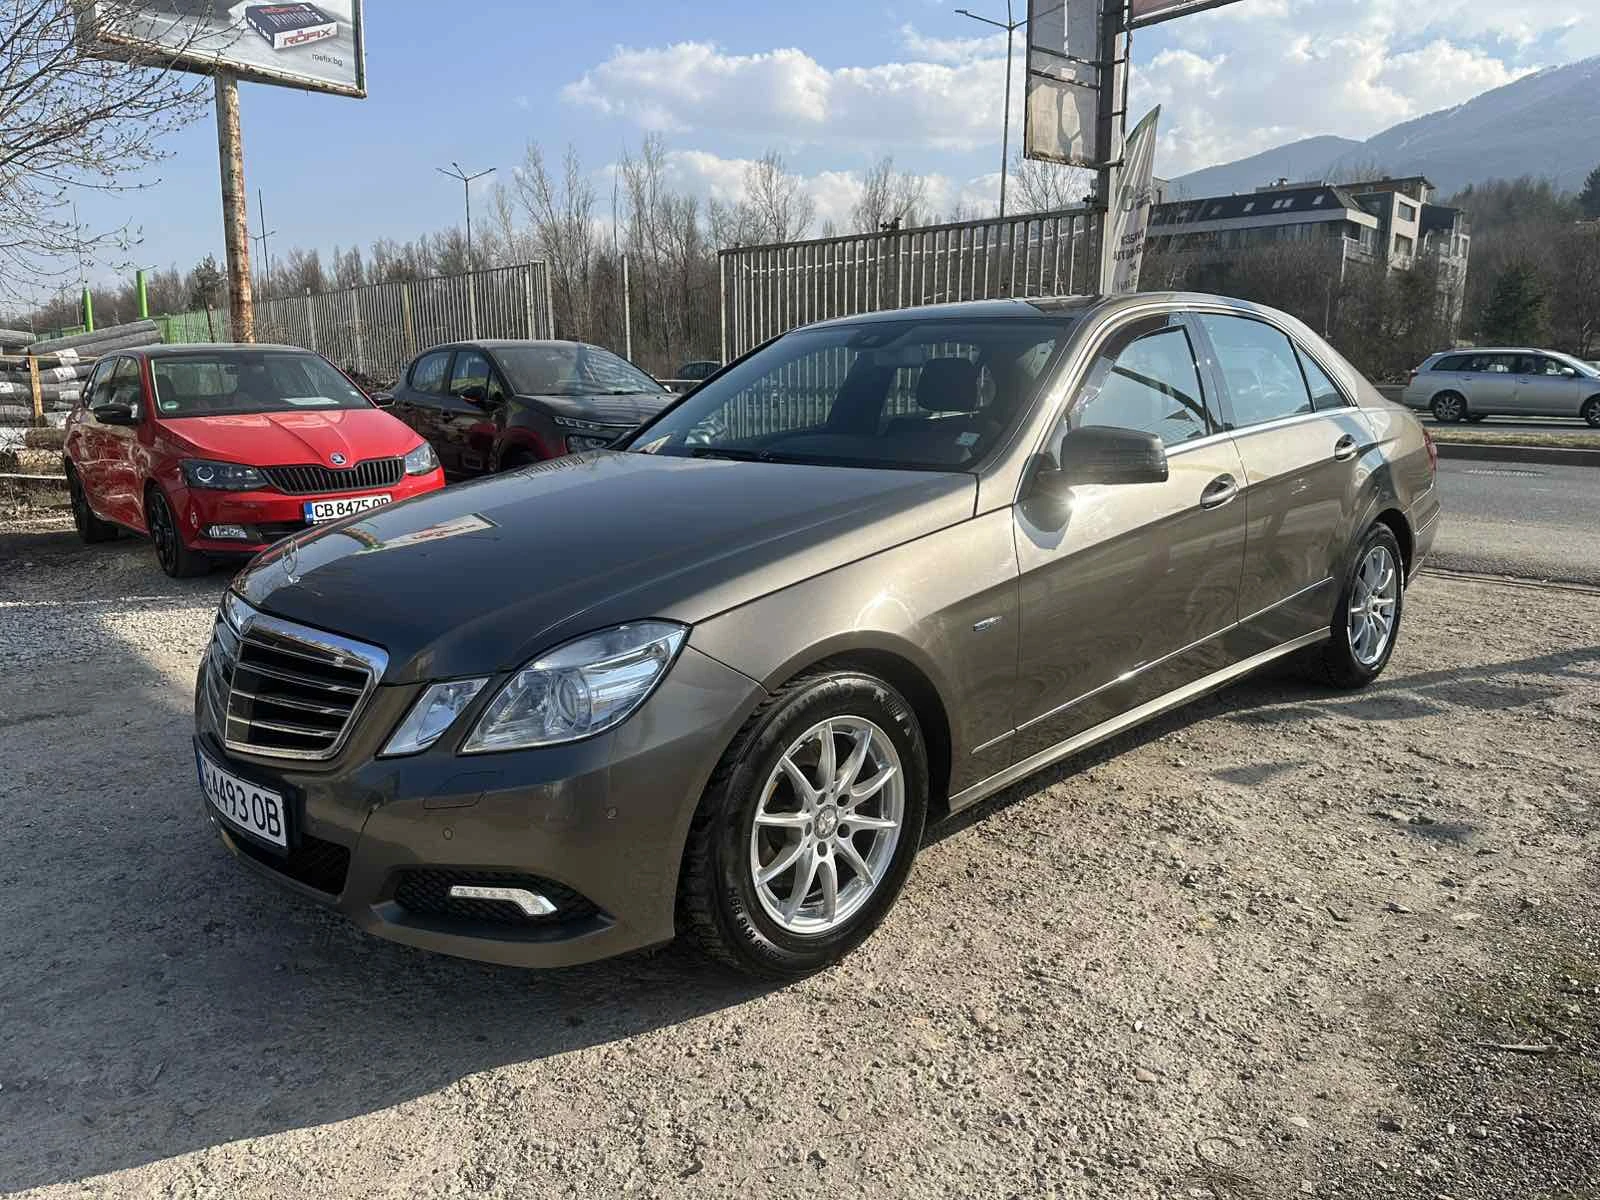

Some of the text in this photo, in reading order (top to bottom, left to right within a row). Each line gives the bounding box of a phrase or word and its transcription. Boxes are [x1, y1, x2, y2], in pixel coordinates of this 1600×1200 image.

[314, 503, 334, 518] CB
[336, 499, 370, 515] 8475
[213, 769, 249, 822] 4493
[252, 793, 282, 837] OB
